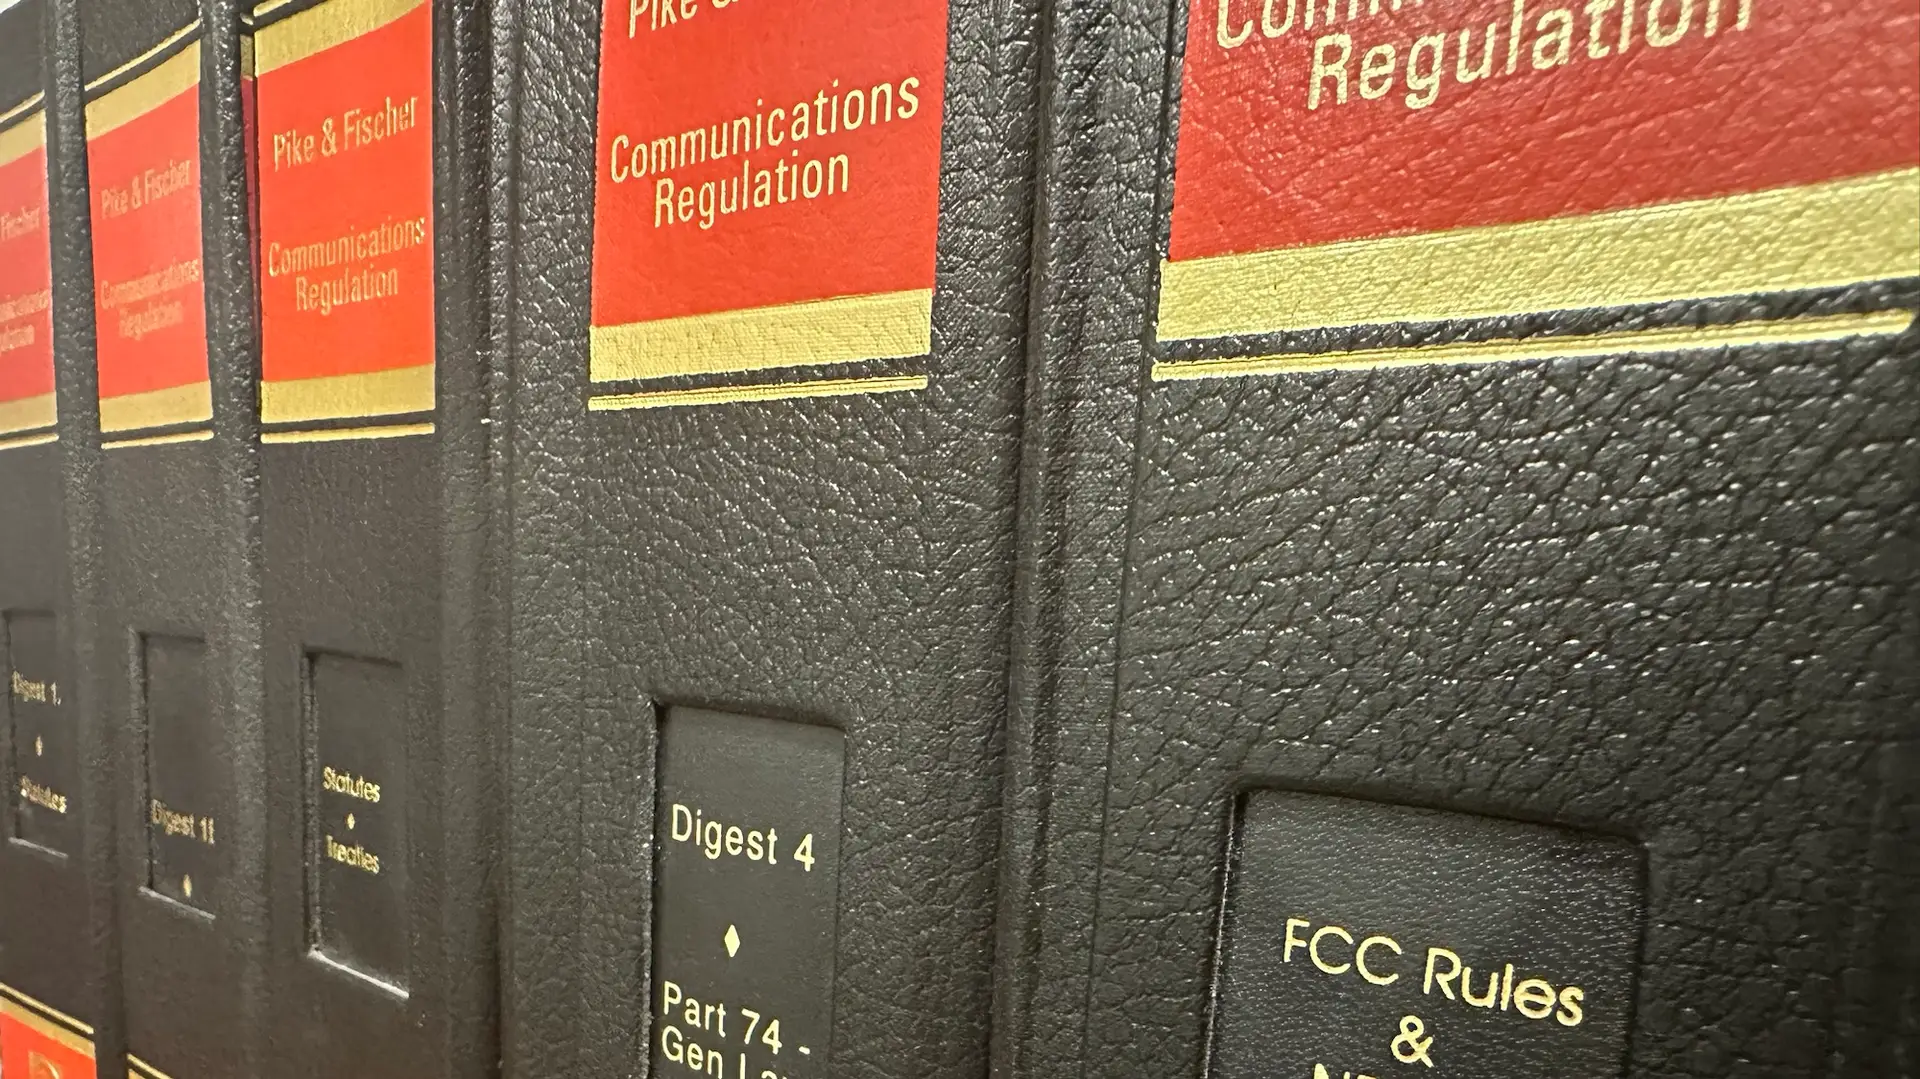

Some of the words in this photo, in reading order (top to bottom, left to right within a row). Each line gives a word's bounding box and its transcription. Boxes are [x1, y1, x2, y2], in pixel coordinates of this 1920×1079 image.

[1303, 0, 1752, 110] Regulation
[273, 129, 315, 172] Pike
[321, 117, 338, 157] &
[343, 96, 418, 151] Fischer
[611, 76, 920, 183] Communications
[655, 150, 849, 231] Regulation
[268, 215, 426, 277] Communications
[295, 263, 398, 316] Regulation
[323, 766, 381, 803] Statutes
[326, 834, 380, 875] Treaties
[672, 804, 778, 865] Digest
[793, 833, 816, 872] 4
[1283, 918, 1402, 985] FCC
[1423, 947, 1585, 1026] Rules
[663, 980, 727, 1038] Part
[741, 1008, 783, 1055] 74
[1391, 1015, 1434, 1067] &
[661, 1025, 724, 1079] Gen
